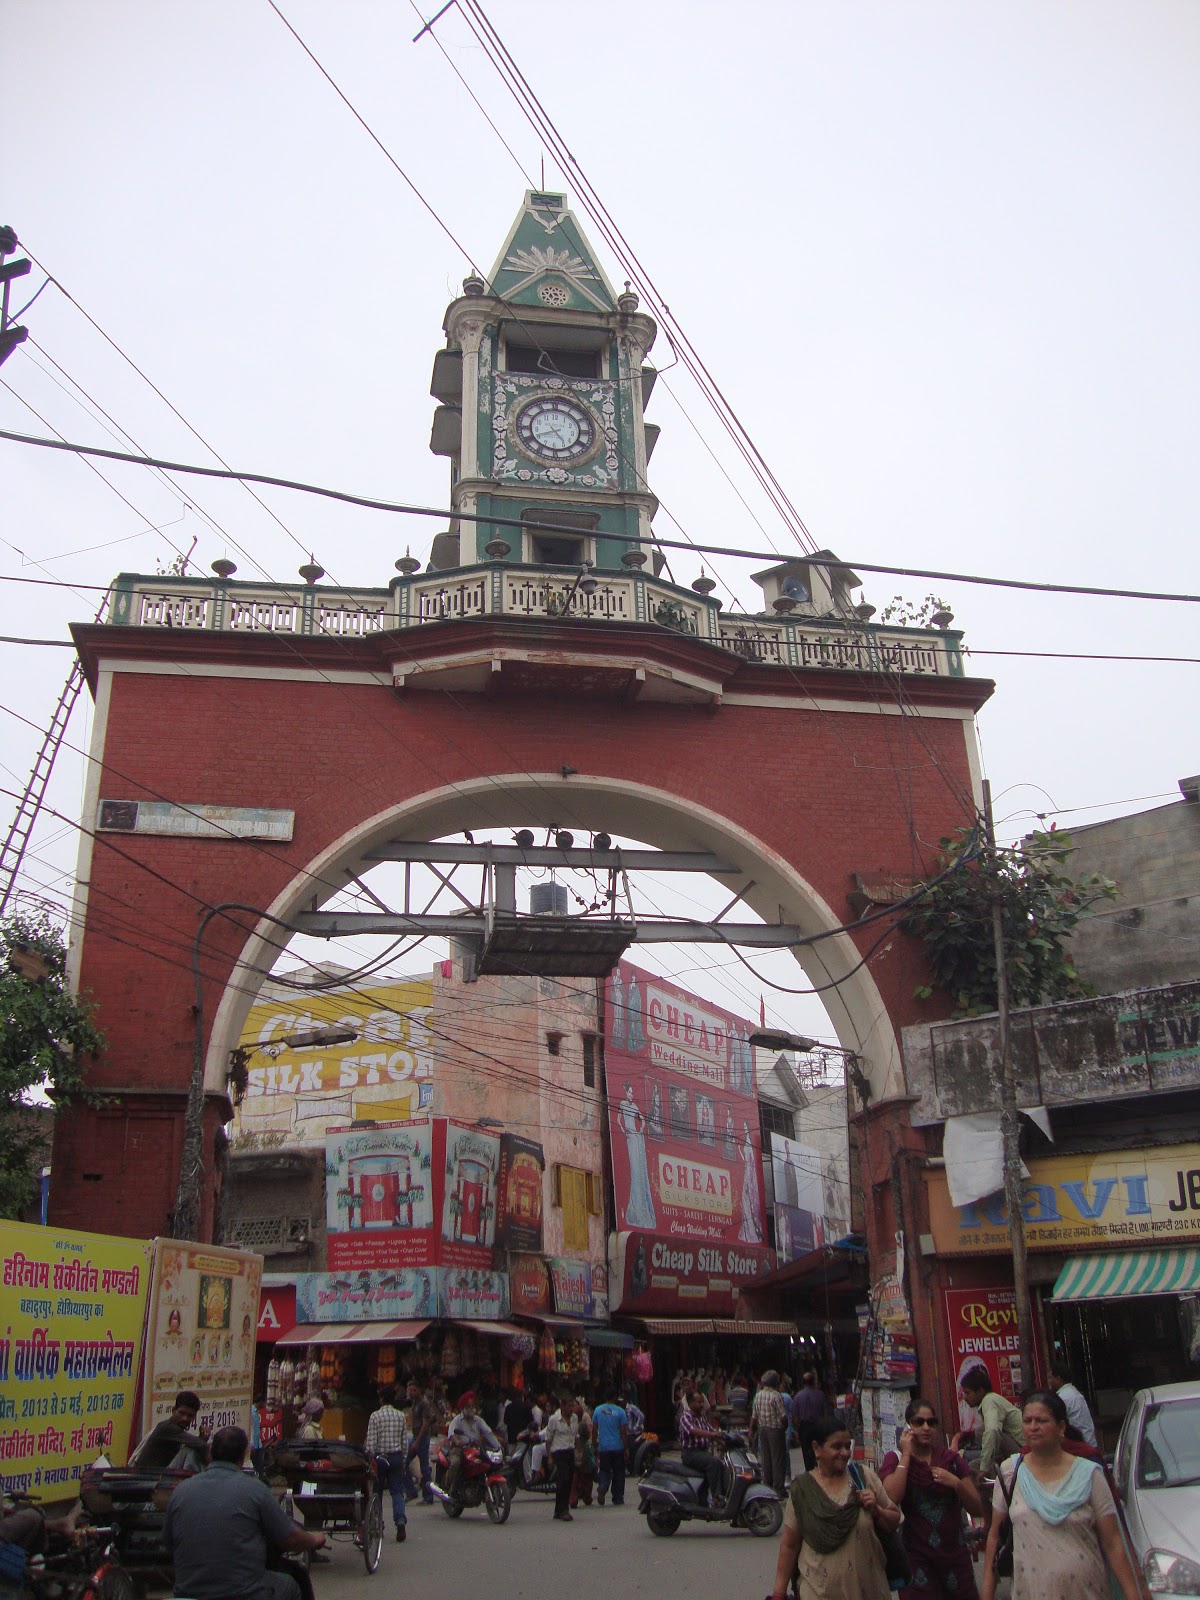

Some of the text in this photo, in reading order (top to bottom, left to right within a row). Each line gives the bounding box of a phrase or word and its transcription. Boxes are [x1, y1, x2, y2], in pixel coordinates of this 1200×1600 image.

[649, 997, 724, 1057] CHEAP
[247, 1050, 434, 1097] SILK STOR
[653, 1043, 724, 1084] Wedding Mall
[662, 1161, 729, 1197] CHEAP
[662, 1206, 679, 1217] SUITS
[664, 1190, 729, 1211] SILK STORE
[3, 1251, 140, 1296] हरिनाम संकीर्तन मण्डली
[651, 1242, 758, 1277] Cheap Silk Store
[258, 1299, 281, 1329] A
[961, 1303, 1018, 1335] Ravi
[15, 1327, 61, 1381] वार्षिक
[64, 1330, 135, 1380] महासम्मेलन
[958, 1335, 1019, 1354] JEWELLER
[22, 1398, 49, 1418] 2013
[60, 1396, 67, 1415] 5
[87, 1394, 110, 1413] 2013
[111, 1392, 125, 1410] तक
[217, 1411, 237, 1428] 2013
[70, 1422, 86, 1453] नई
